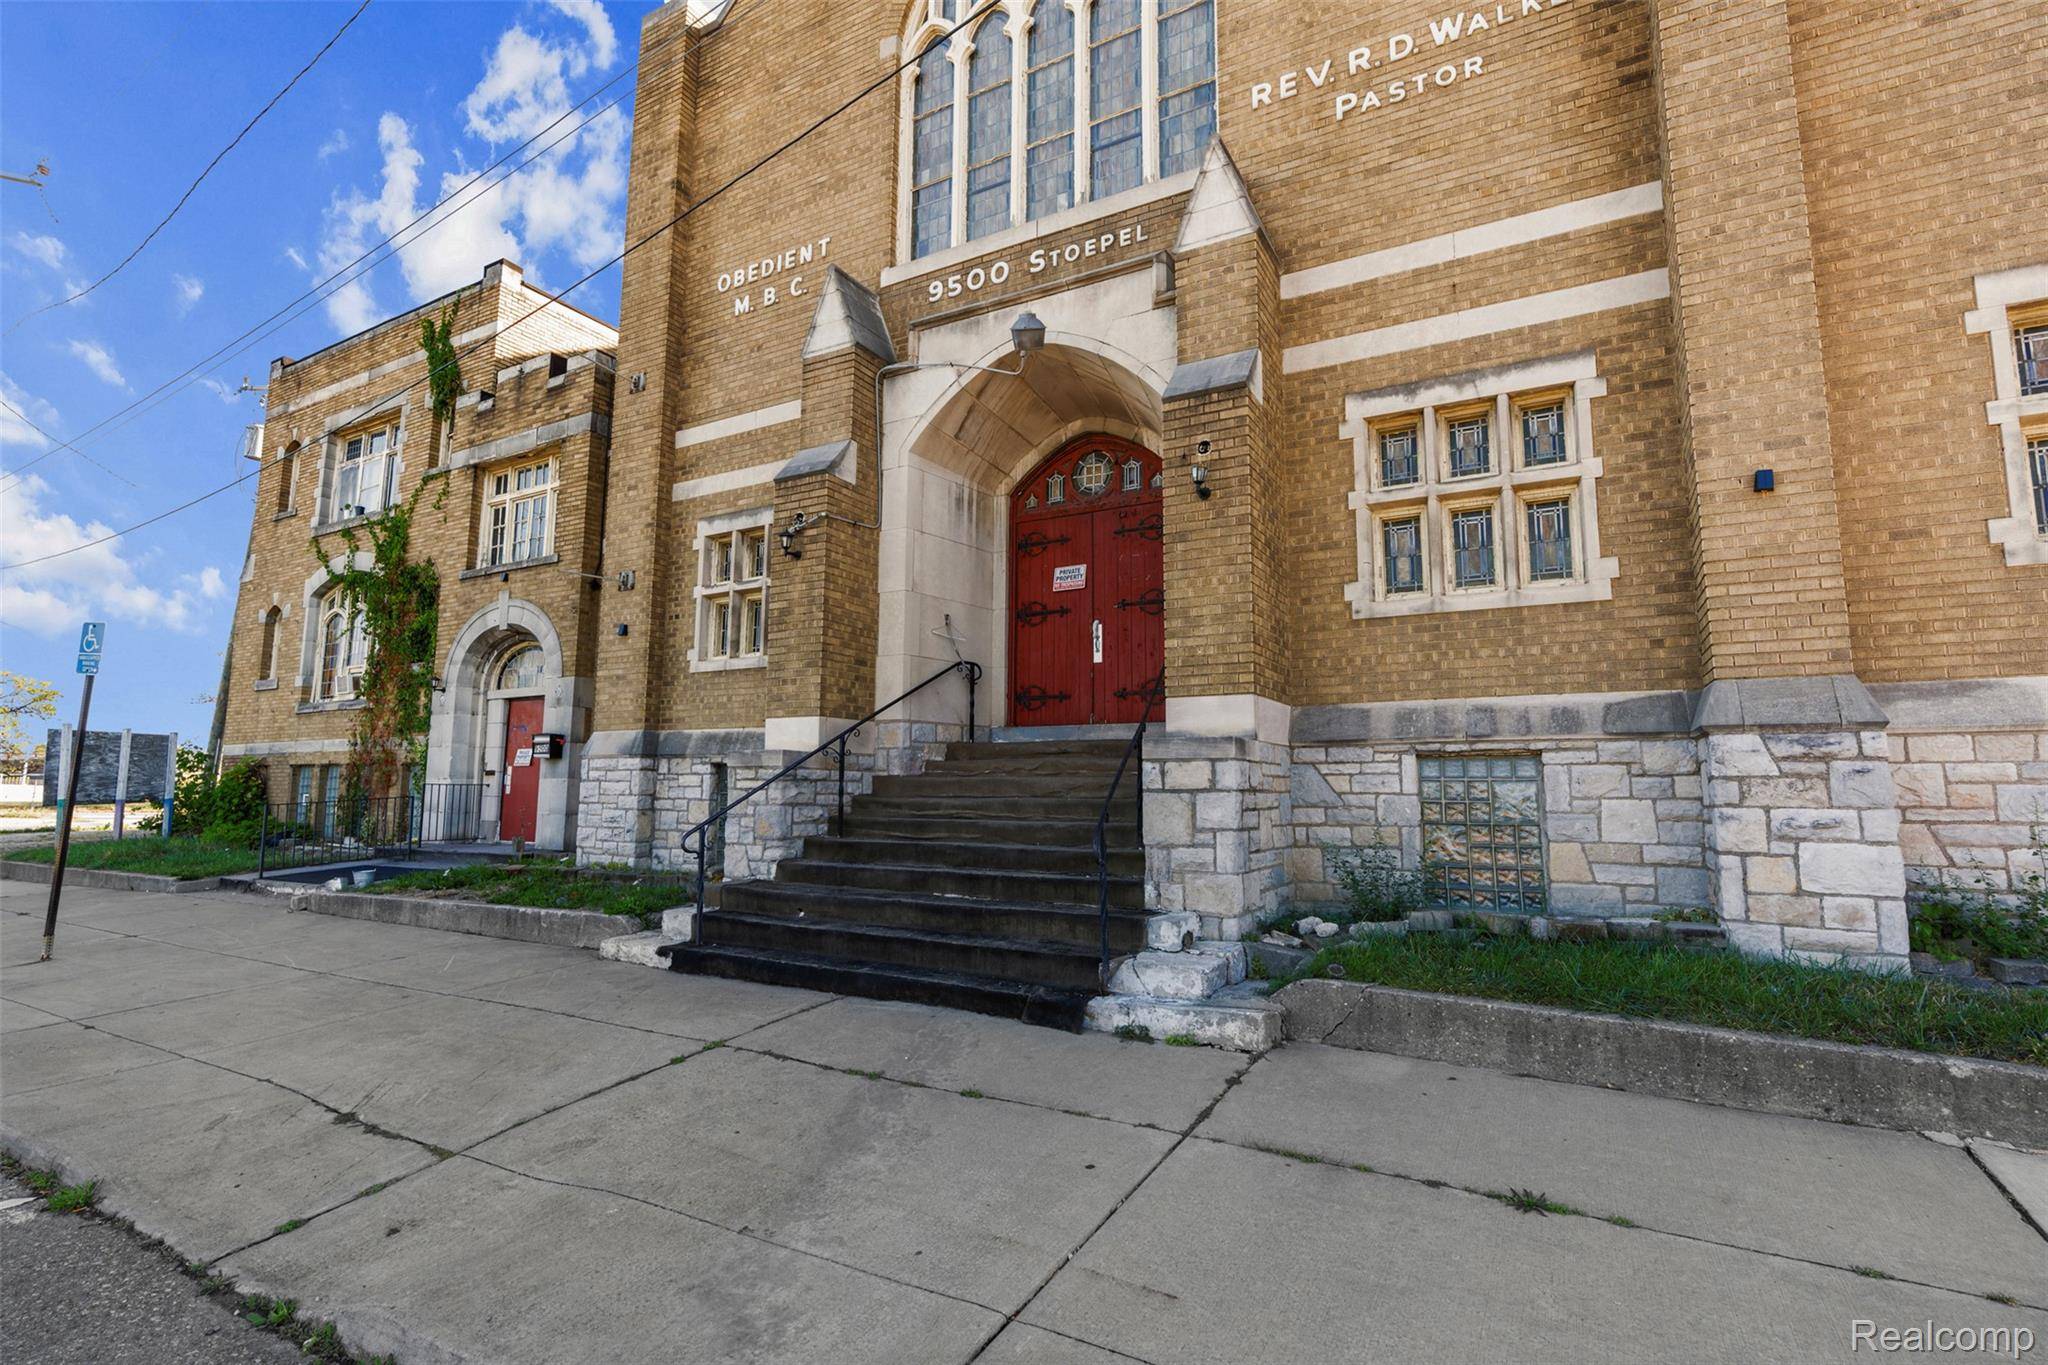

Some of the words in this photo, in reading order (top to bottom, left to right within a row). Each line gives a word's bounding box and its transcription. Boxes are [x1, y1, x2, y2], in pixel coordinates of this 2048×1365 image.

[1251, 59, 1336, 111] REV.
[1429, 0, 1570, 46] WALK
[1335, 55, 1484, 121] PASTOR
[717, 236, 832, 293] OBEDIENT
[928, 261, 1010, 303] 9500
[1055, 573, 1084, 582] PROPERTY
[1059, 567, 1081, 576] PRIVATE
